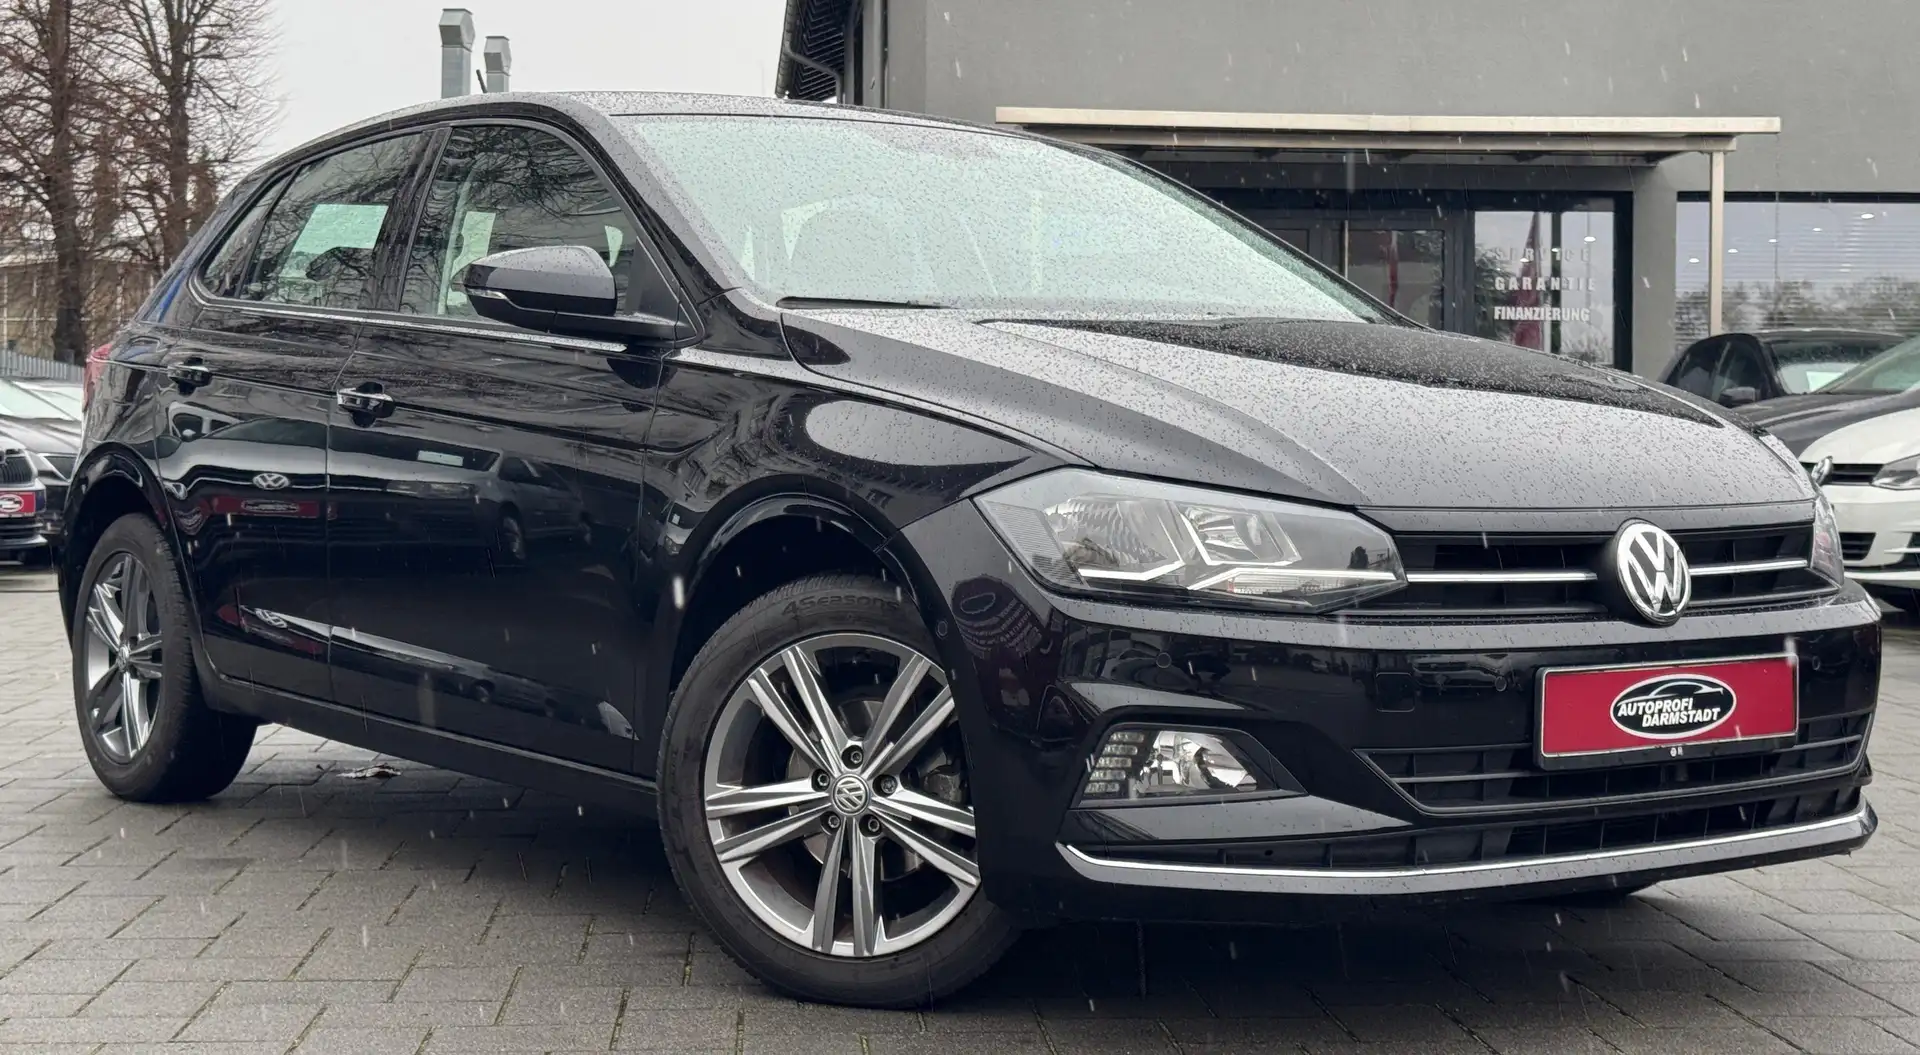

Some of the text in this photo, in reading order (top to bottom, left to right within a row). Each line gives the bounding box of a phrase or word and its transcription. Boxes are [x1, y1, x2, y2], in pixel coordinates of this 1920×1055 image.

[1495, 276, 1595, 291] GARANTIE
[1494, 306, 1590, 321] FINANZIERUNG
[1617, 523, 1692, 625] VW
[1617, 697, 1694, 717] AUTOPROFI
[1641, 707, 1721, 728] DARMSTADT
